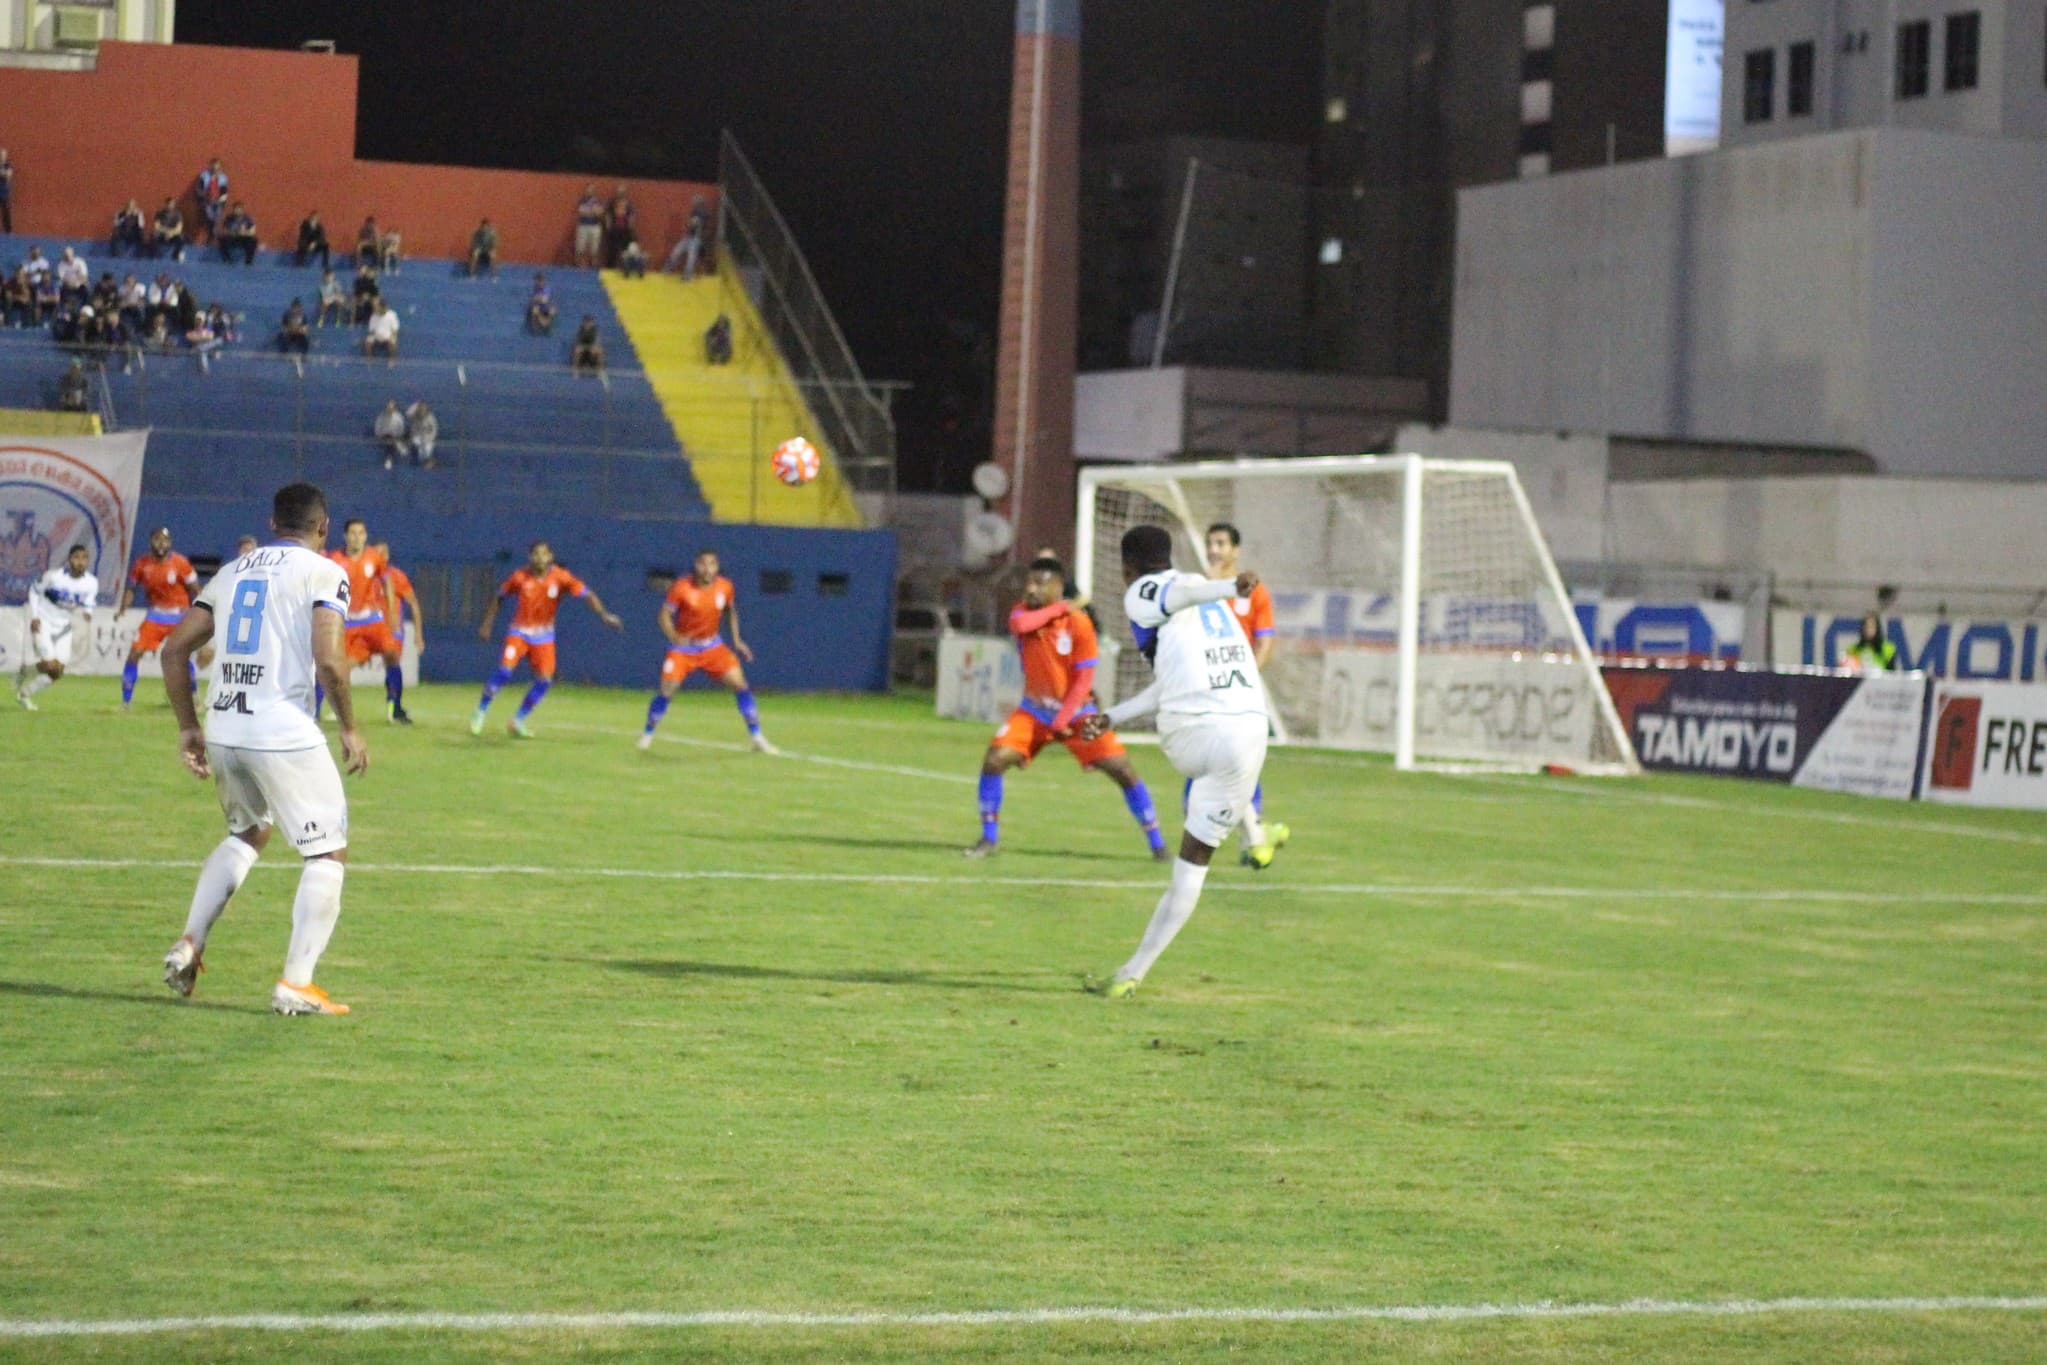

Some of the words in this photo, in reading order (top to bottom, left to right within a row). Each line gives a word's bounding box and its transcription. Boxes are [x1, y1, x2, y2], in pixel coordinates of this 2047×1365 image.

[226, 580, 269, 654] 8
[1638, 713, 1797, 773] TAMOYO
[1983, 718, 2047, 775] FRE
